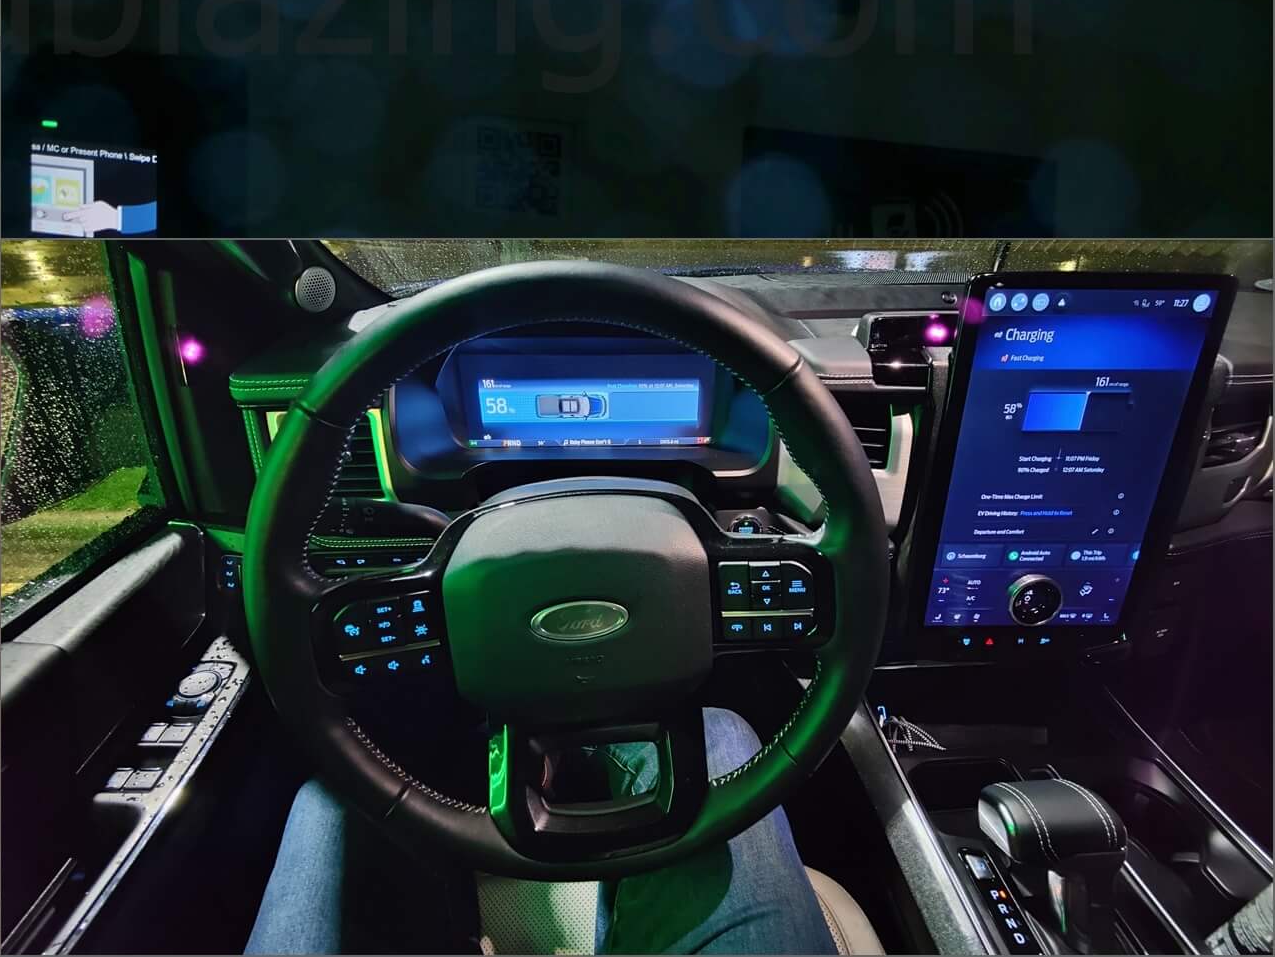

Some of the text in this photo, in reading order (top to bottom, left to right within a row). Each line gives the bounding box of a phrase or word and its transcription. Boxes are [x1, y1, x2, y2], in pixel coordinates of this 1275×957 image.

[1005, 328, 1055, 343] Charging
[482, 380, 494, 389] 161
[1095, 376, 1110, 387] 161
[486, 397, 508, 414] 58
[997, 903, 1009, 915] R
[1013, 932, 1026, 945] D
